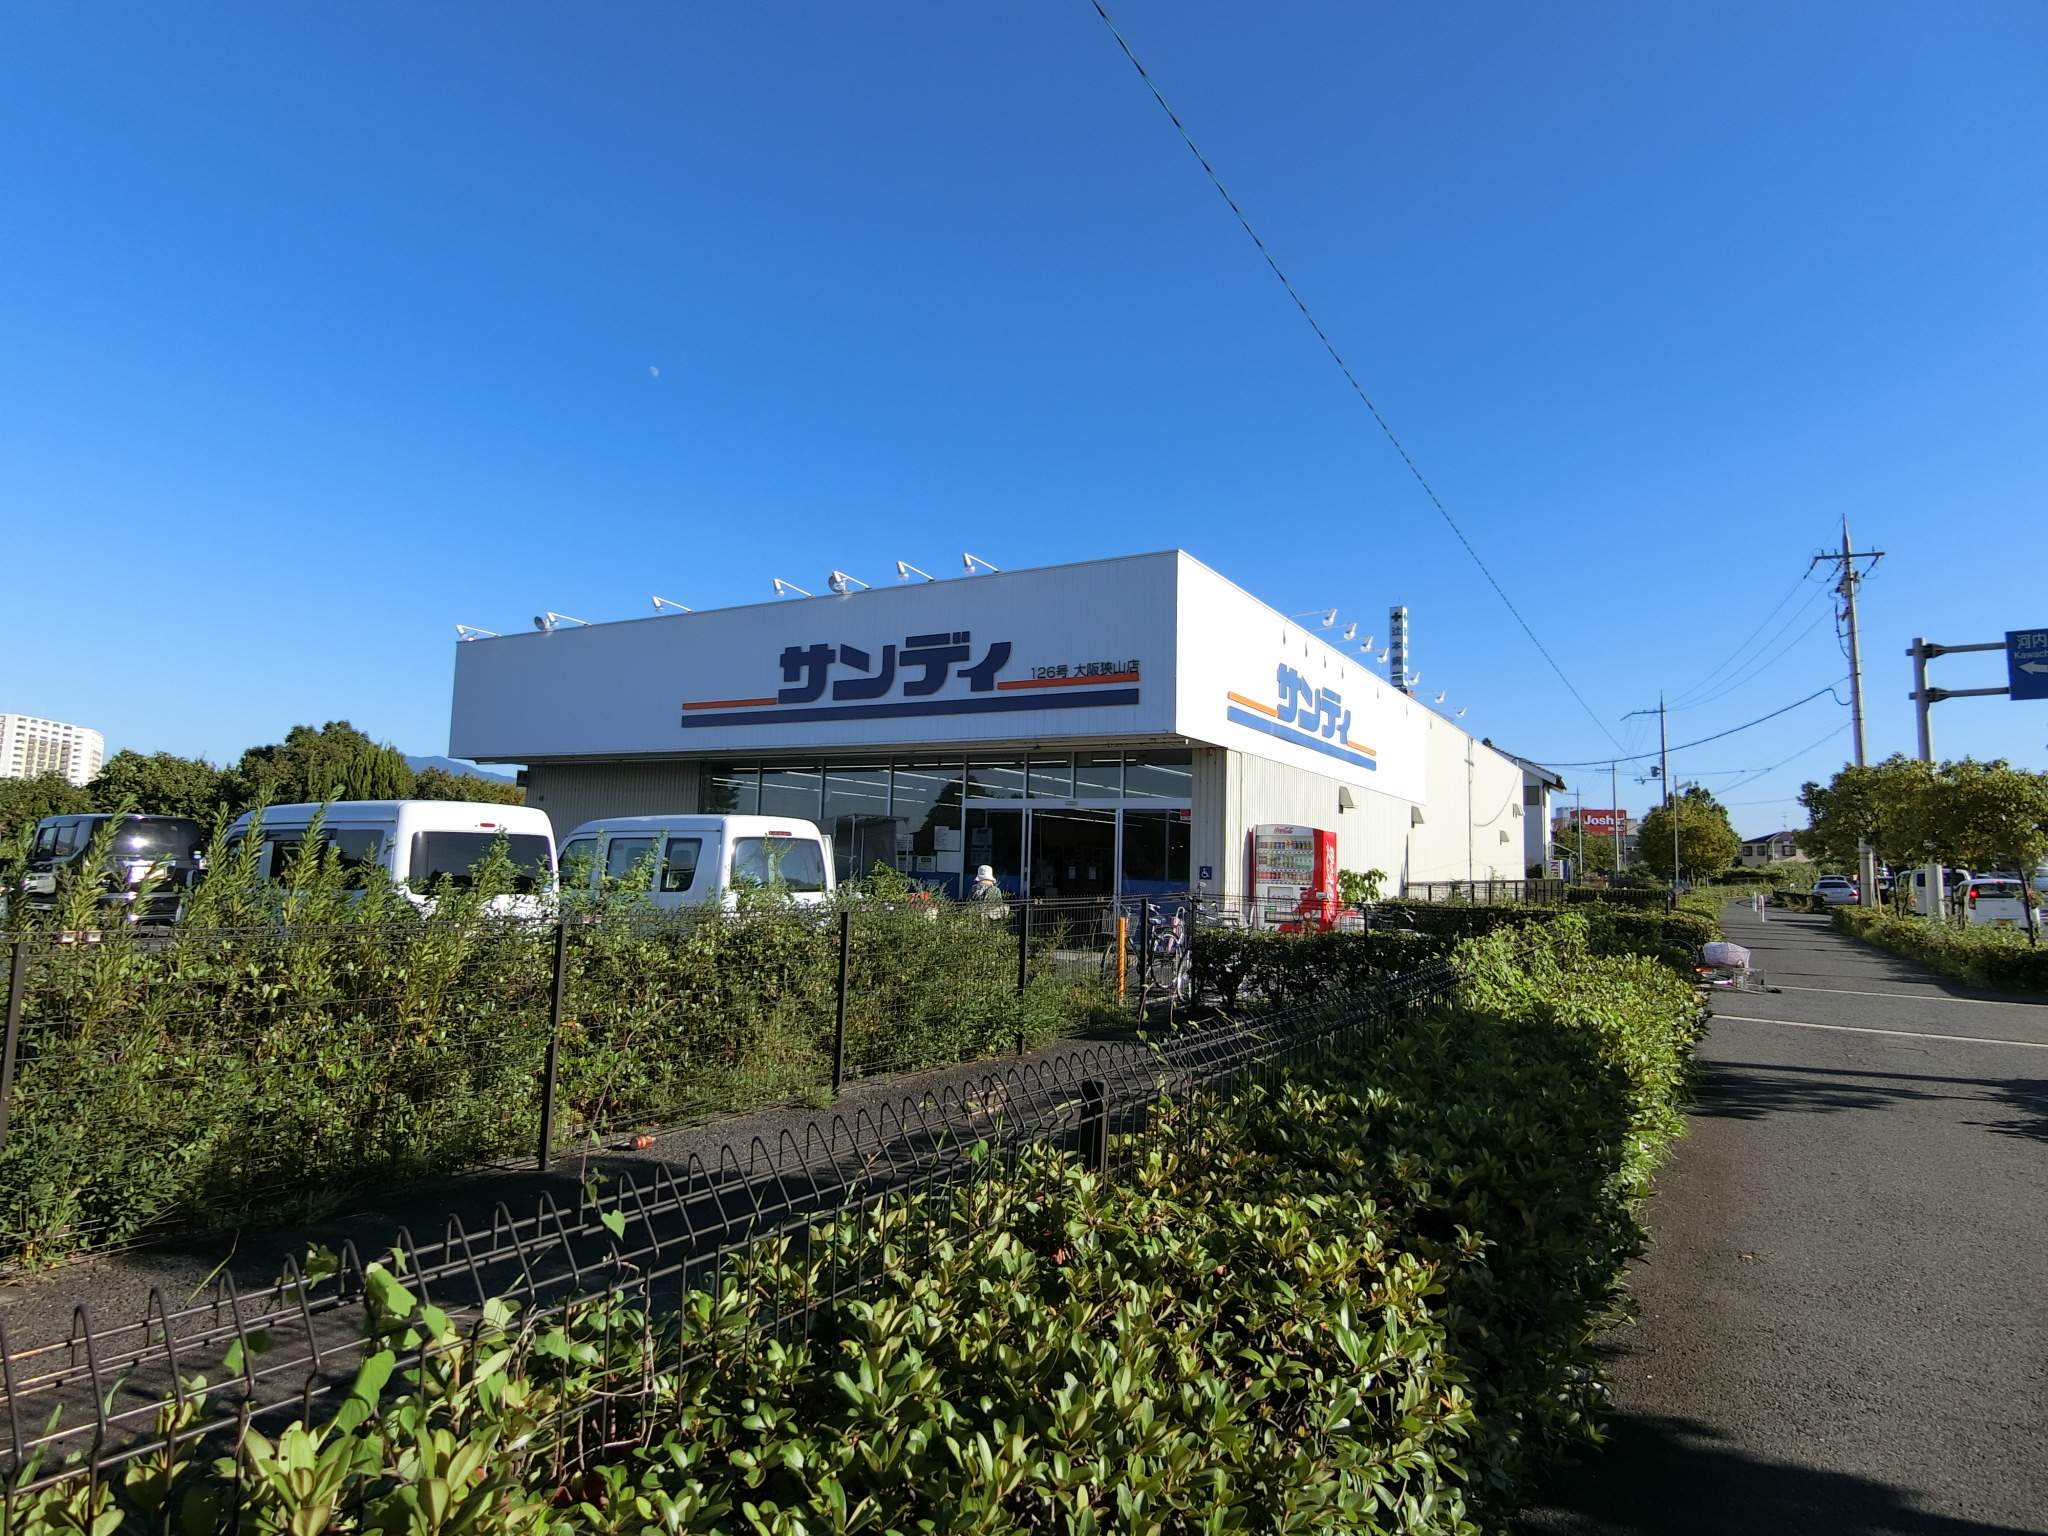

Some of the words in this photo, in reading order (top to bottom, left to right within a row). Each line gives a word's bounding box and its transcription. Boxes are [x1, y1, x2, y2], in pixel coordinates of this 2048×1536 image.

[779, 631, 1012, 704] サンディ
[1031, 665, 1068, 679] 126号
[1074, 659, 1140, 678] 大阪狭山店
[1277, 662, 1351, 745] サンディ
